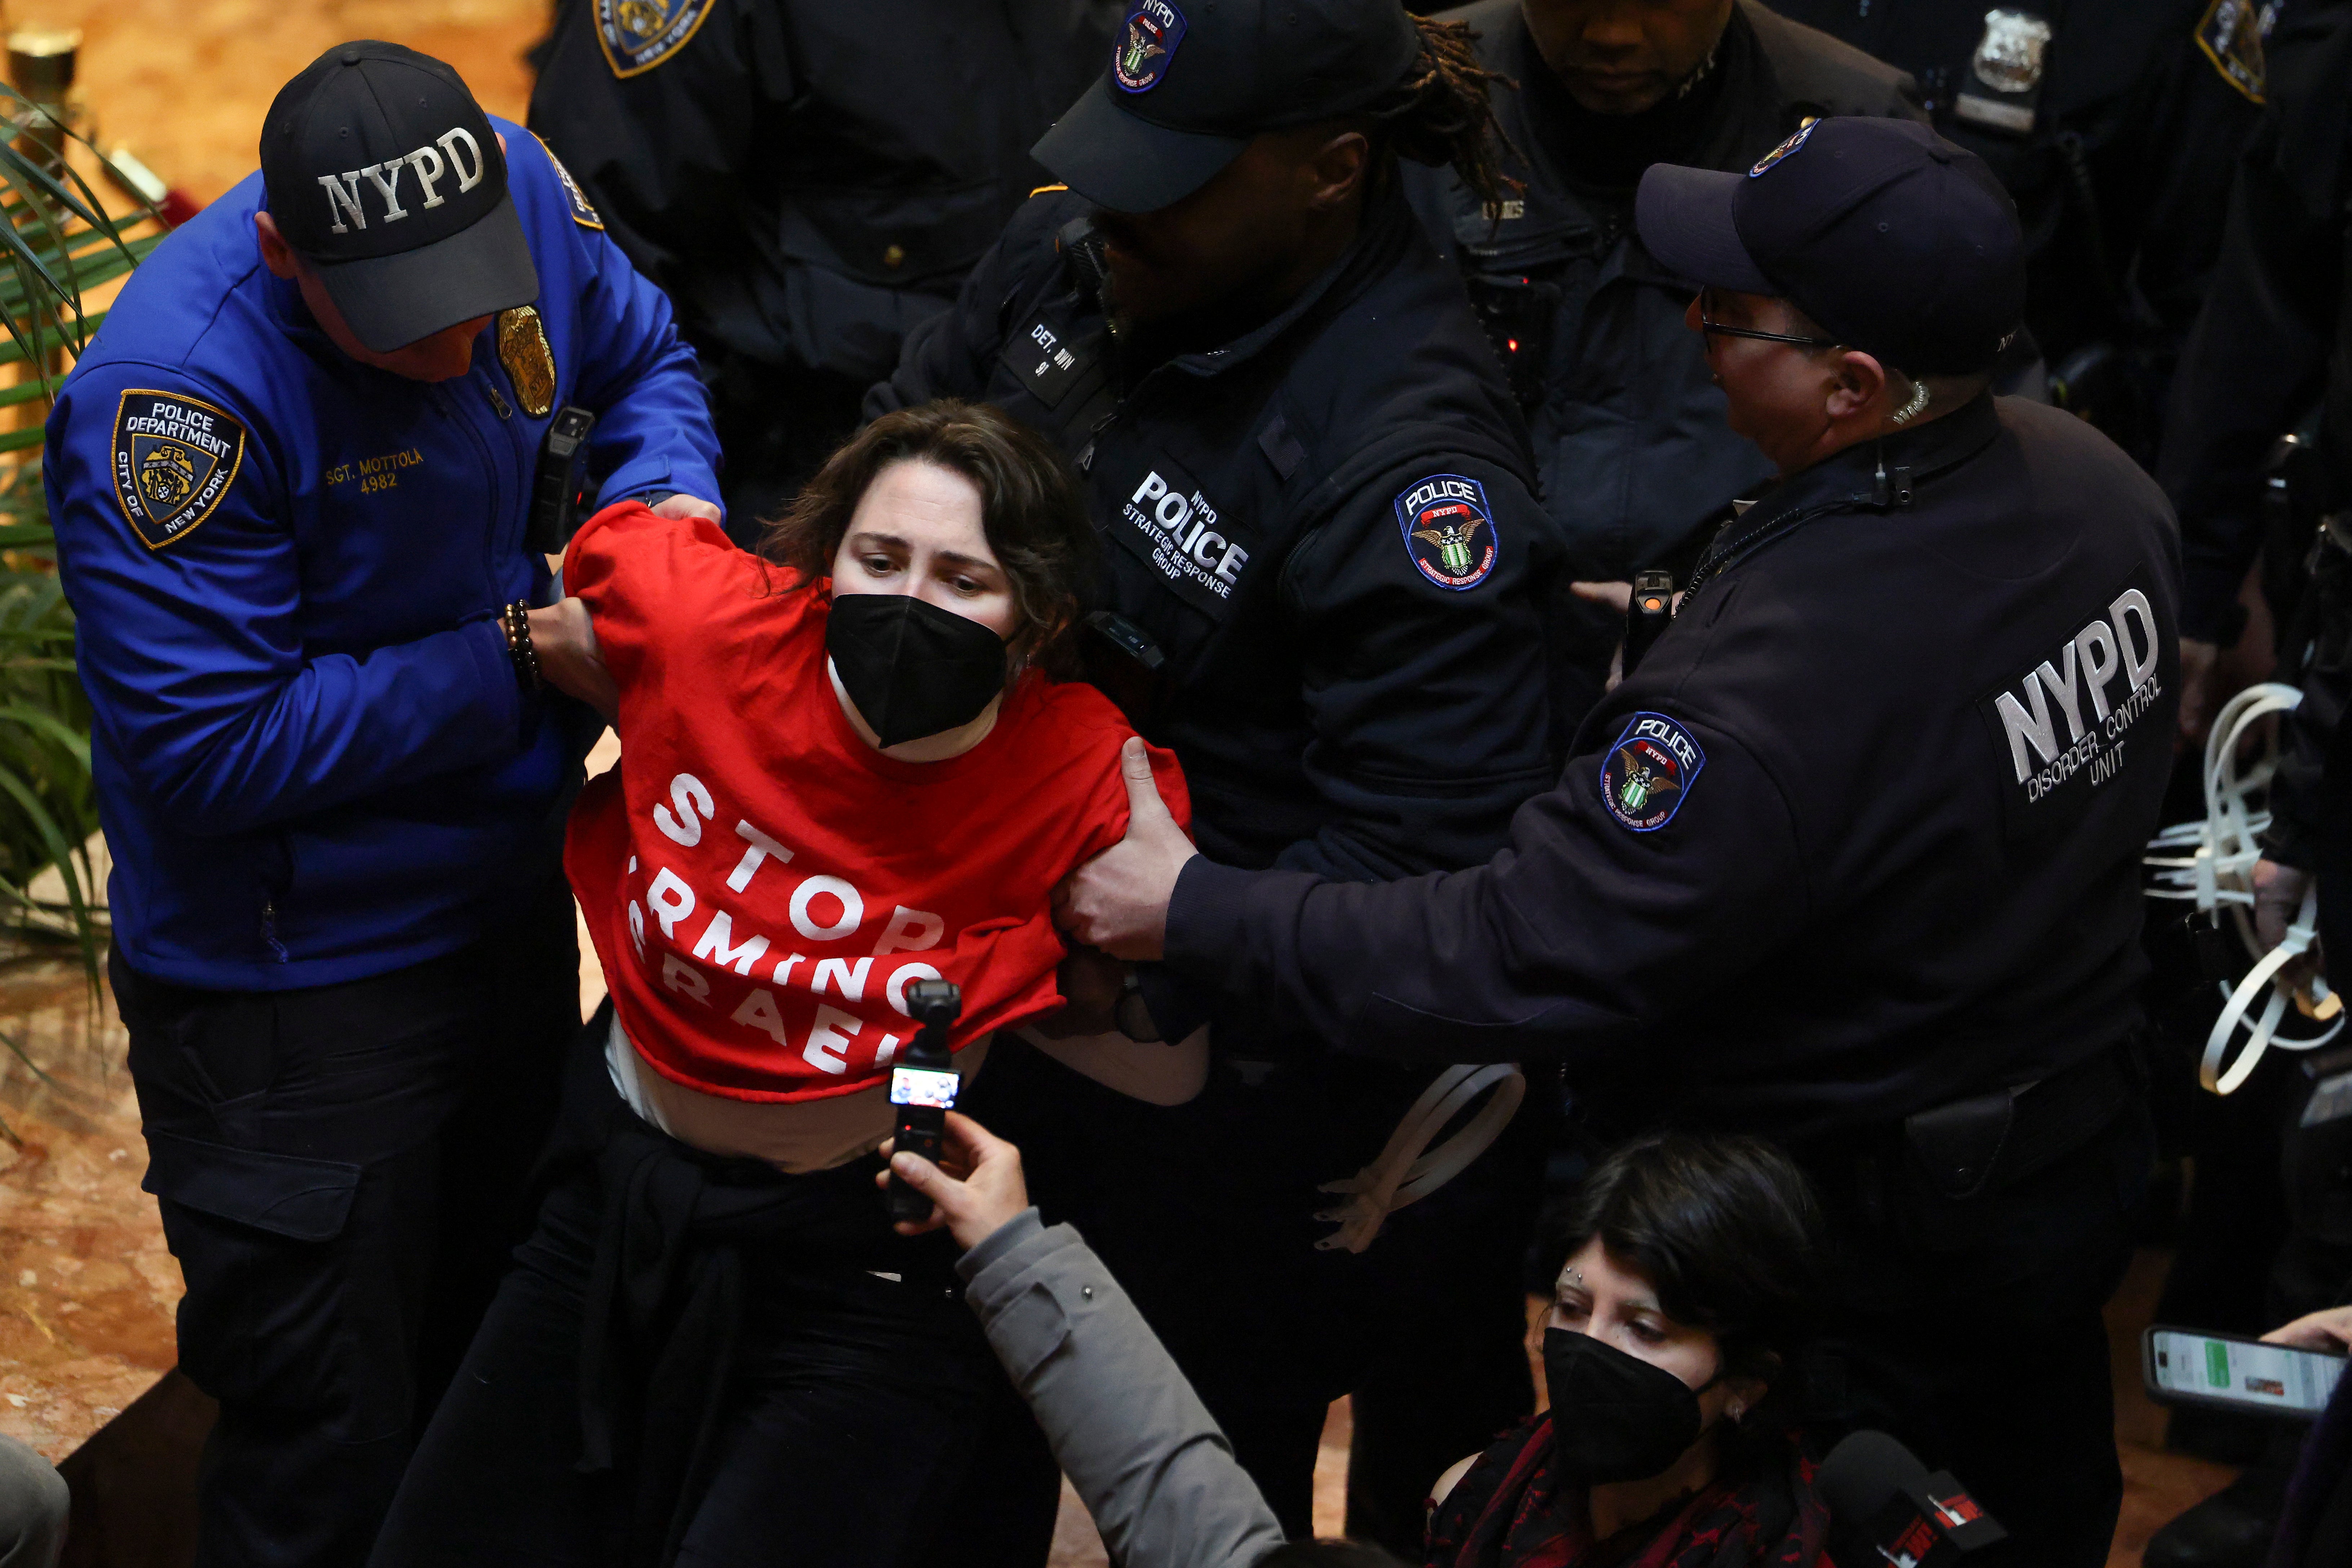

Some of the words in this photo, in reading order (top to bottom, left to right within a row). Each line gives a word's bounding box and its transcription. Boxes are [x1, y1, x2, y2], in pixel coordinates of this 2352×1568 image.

[1142, 0, 1174, 28] NYPD
[318, 127, 484, 234] NYPD
[1030, 324, 1057, 354] DET.
[151, 402, 214, 432] POLICE
[126, 416, 231, 458] DEPARTMENT
[326, 463, 356, 485] SGT.
[359, 448, 424, 476] MOTTOLA
[361, 472, 397, 495] 4982
[118, 451, 133, 490] CITY
[127, 495, 144, 517] OF
[164, 507, 195, 534] NEW
[193, 468, 228, 508] YORK
[1190, 489, 1217, 524] NYPD
[1406, 481, 1477, 516] POLICE
[1131, 470, 1249, 585] POLICE
[1432, 506, 1457, 518] NYPD
[1122, 503, 1174, 555] STRATEGIC
[1170, 550, 1232, 599] RESPONSE
[1152, 547, 1181, 580] GROUP
[1420, 559, 1450, 584] STRATEGIC
[1452, 569, 1483, 585] RESPONSE
[1482, 547, 1494, 569] GROUP
[1994, 588, 2159, 785] NYPD
[1634, 719, 1696, 770] POLICE
[1645, 746, 1668, 765] NYPD
[2028, 730, 2099, 804] DISORDER
[2106, 672, 2162, 741] CONTROL
[2090, 740, 2126, 786] UNIT
[1615, 809, 1643, 827] RESPONSE
[1646, 810, 1666, 827] GROUP
[653, 773, 945, 956] STOP
